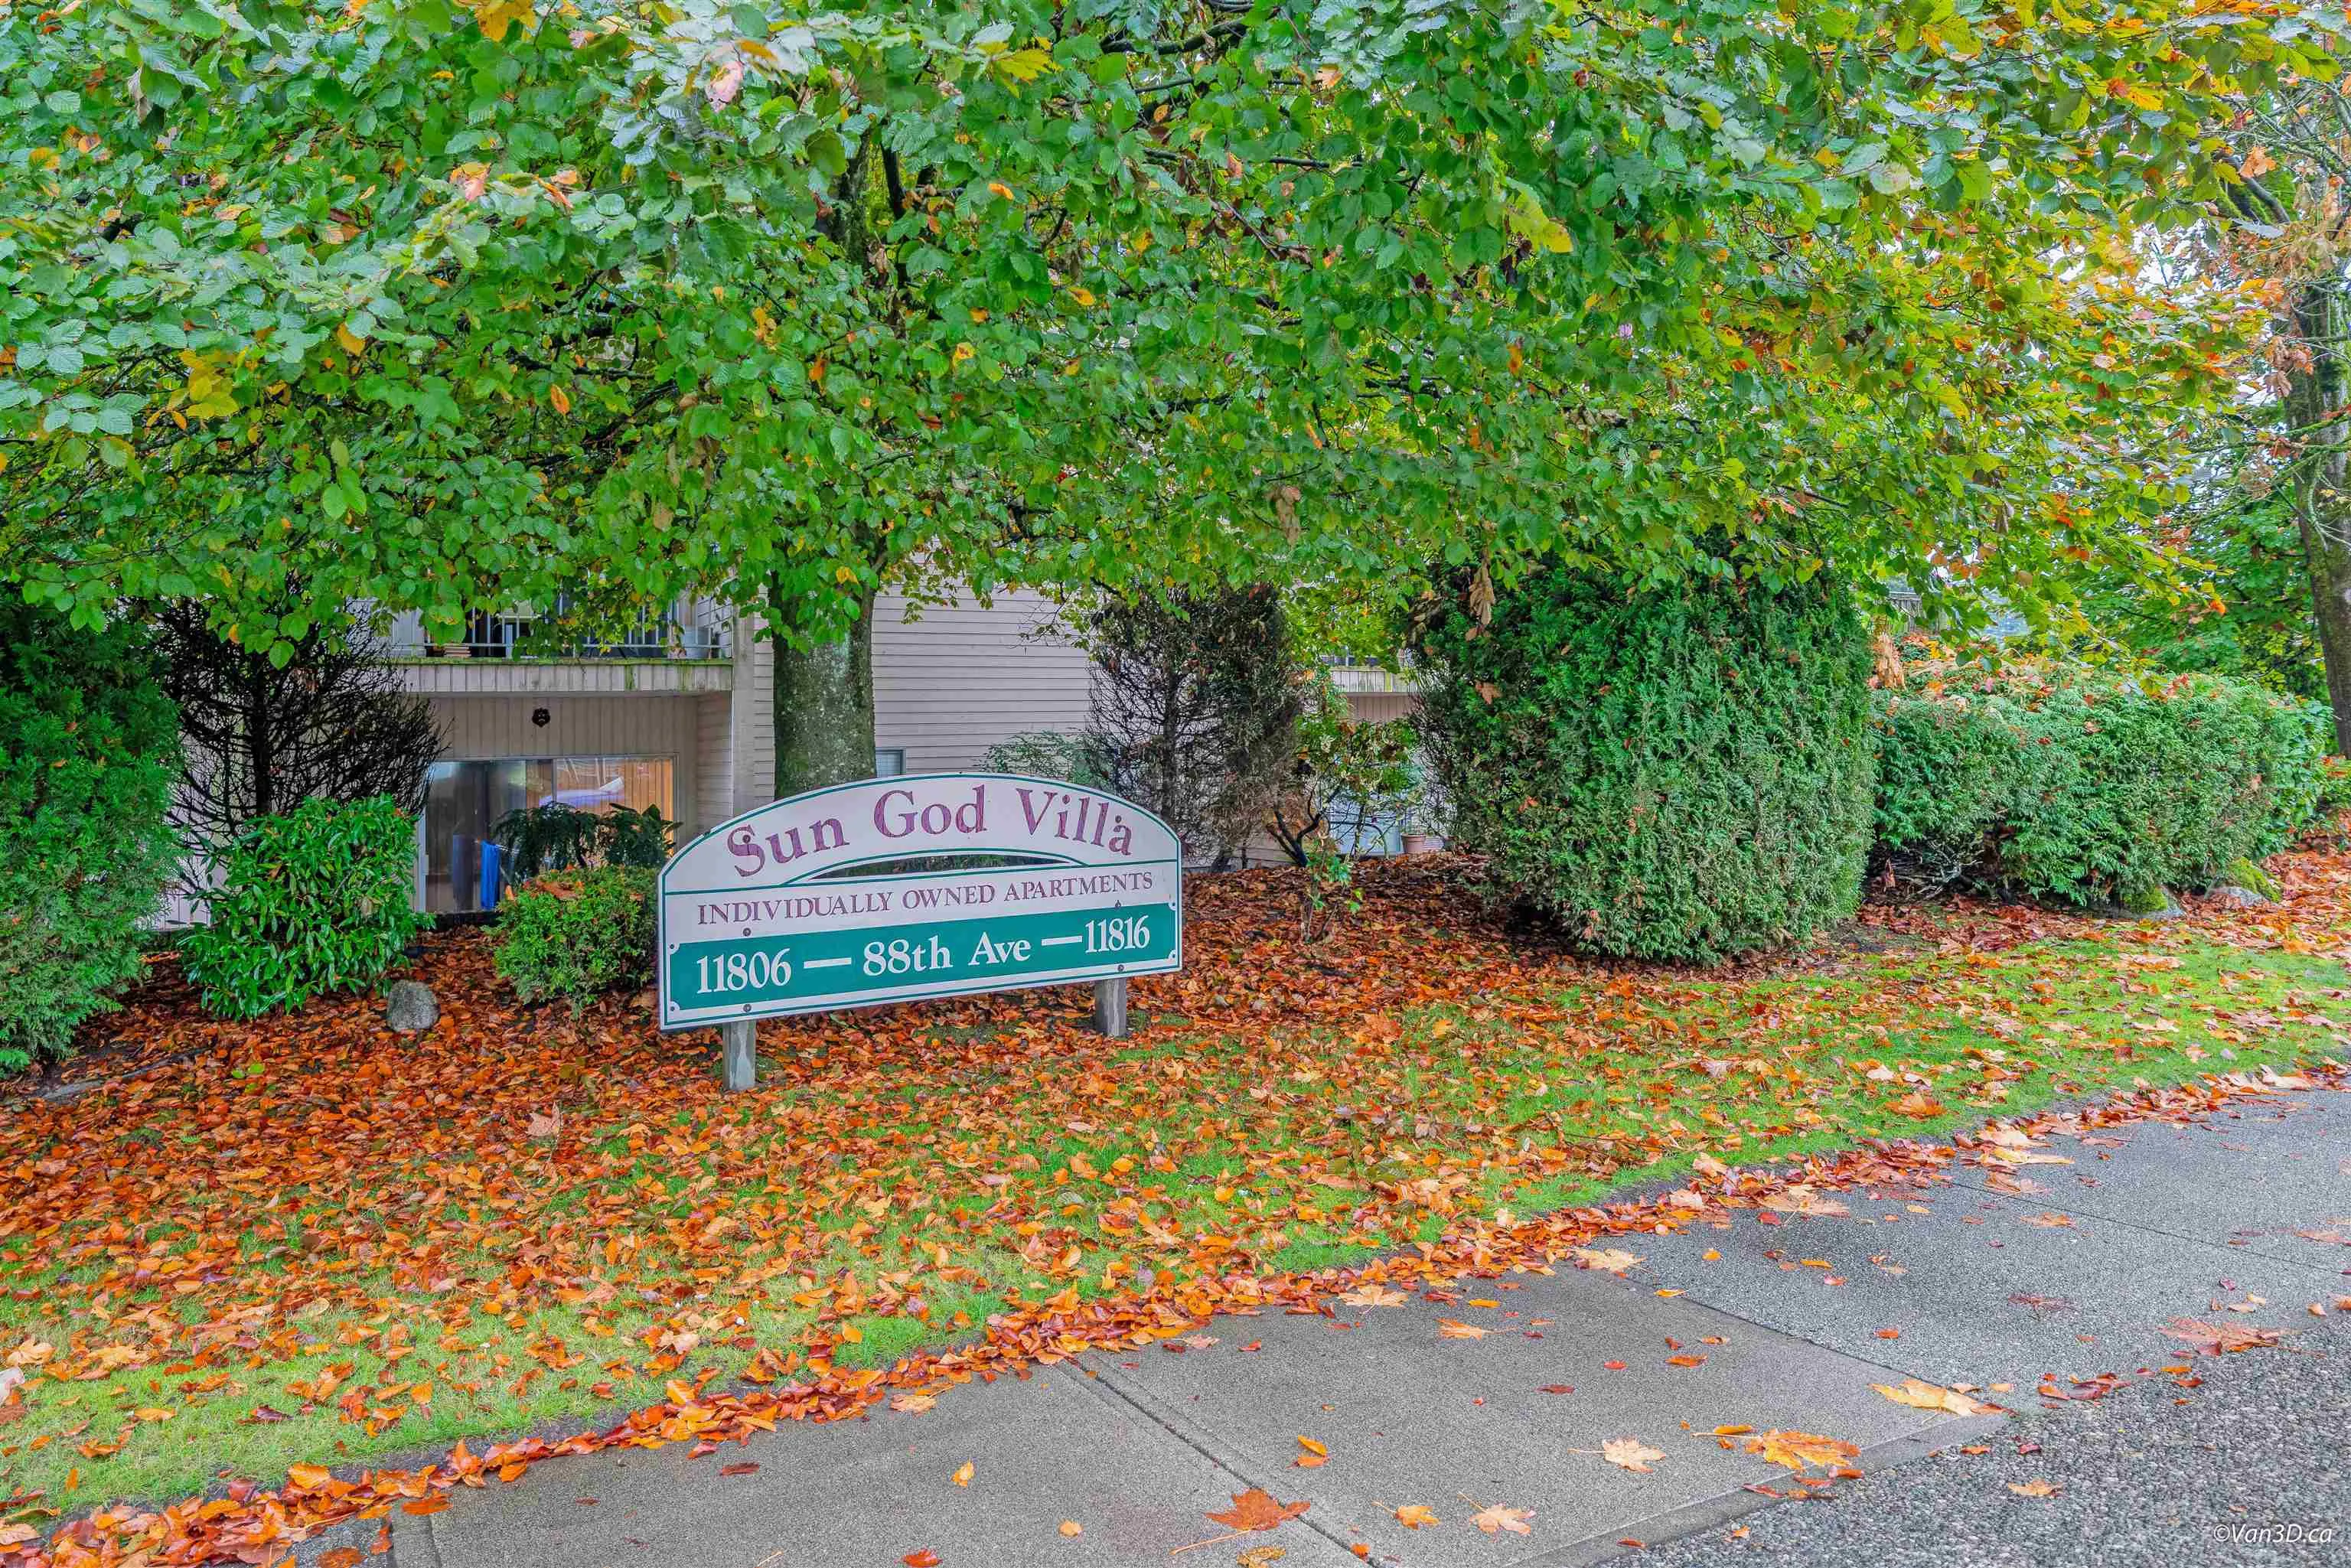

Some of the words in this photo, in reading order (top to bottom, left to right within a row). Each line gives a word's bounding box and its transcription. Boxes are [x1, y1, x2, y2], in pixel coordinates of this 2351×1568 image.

[726, 817, 849, 878] Sun
[873, 784, 988, 839] God
[1016, 787, 1134, 856] Villa
[697, 892, 895, 925] INDIVIDUALLY
[902, 884, 995, 911] OWNED
[1003, 872, 1153, 902] APARTMENTS
[696, 947, 792, 994] 11806
[862, 934, 954, 976] 88th
[967, 931, 1032, 967] Ave
[1084, 914, 1150, 954] 11816
